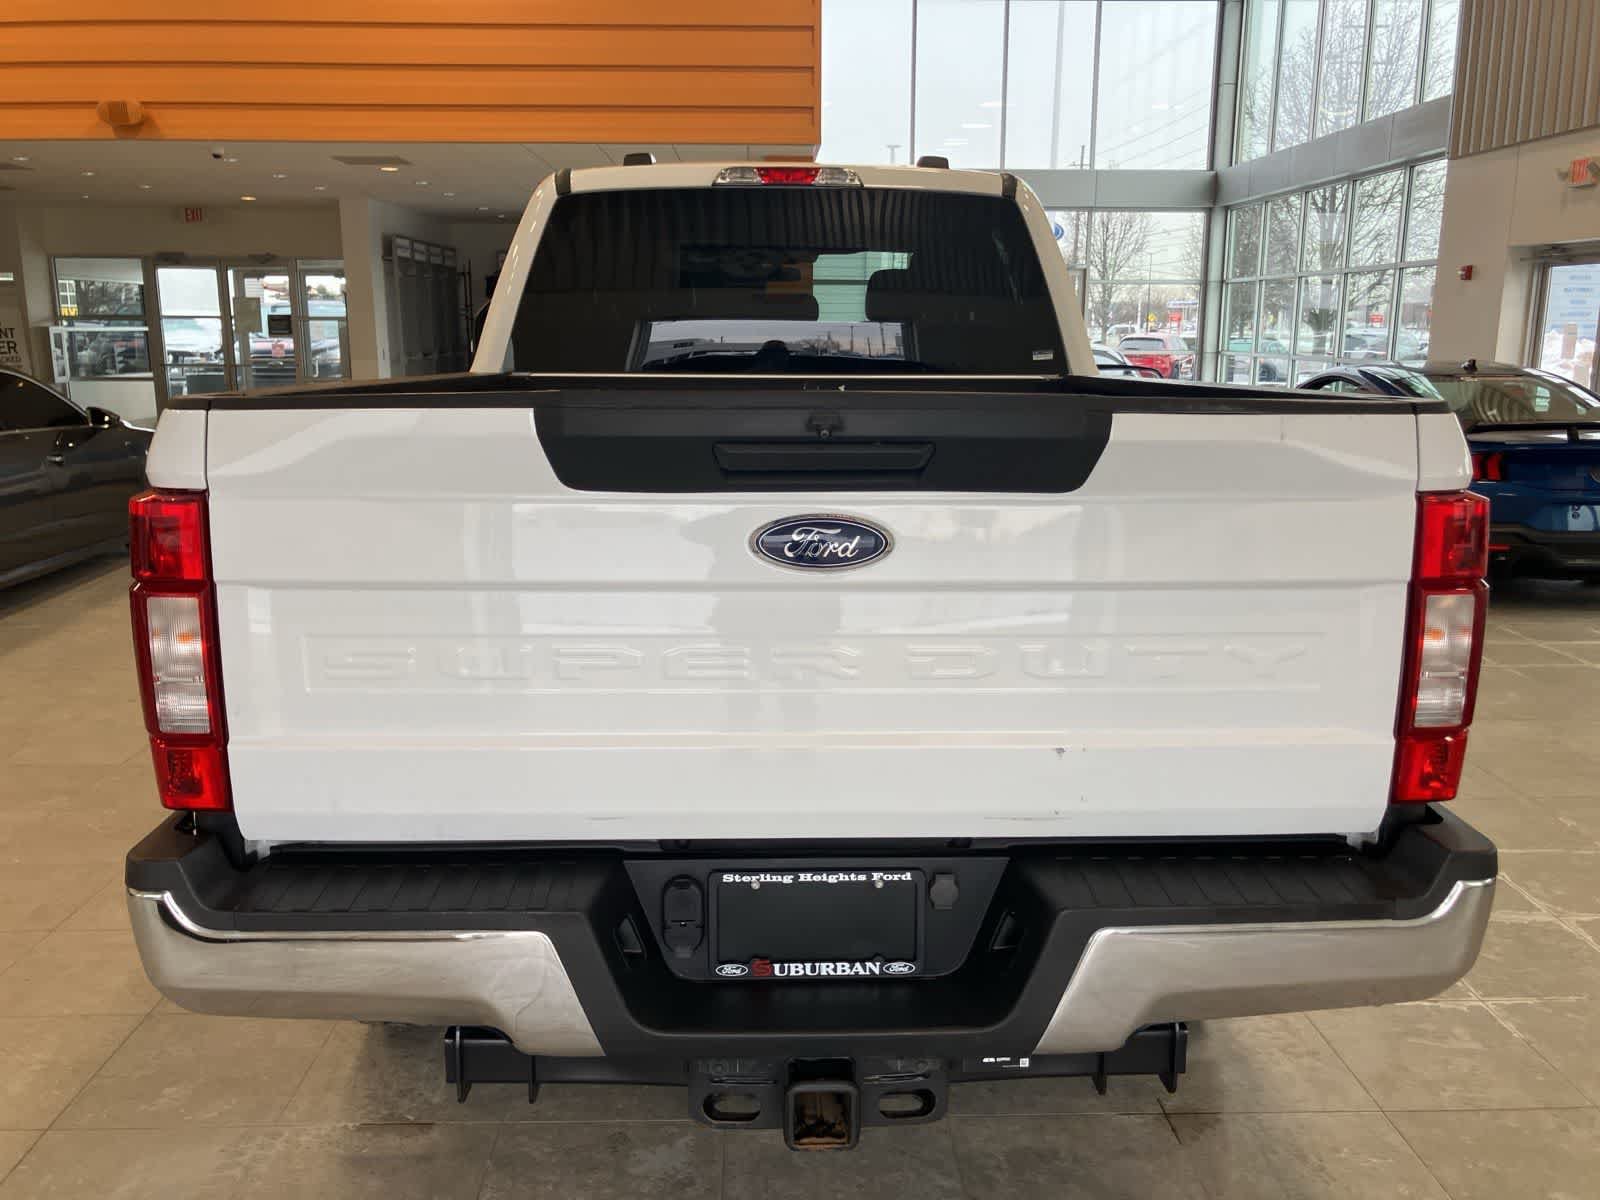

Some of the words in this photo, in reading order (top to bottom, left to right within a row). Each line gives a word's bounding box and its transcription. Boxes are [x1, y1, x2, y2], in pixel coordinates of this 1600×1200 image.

[185, 207, 202, 223] EXIT
[784, 527, 860, 557] Ford
[323, 642, 863, 681] SUPER
[904, 641, 1307, 681] DUTY
[722, 873, 794, 883] Sterling
[798, 872, 867, 883] Heights
[871, 872, 912, 882] Ford
[752, 958, 881, 977] SUBURBAN
